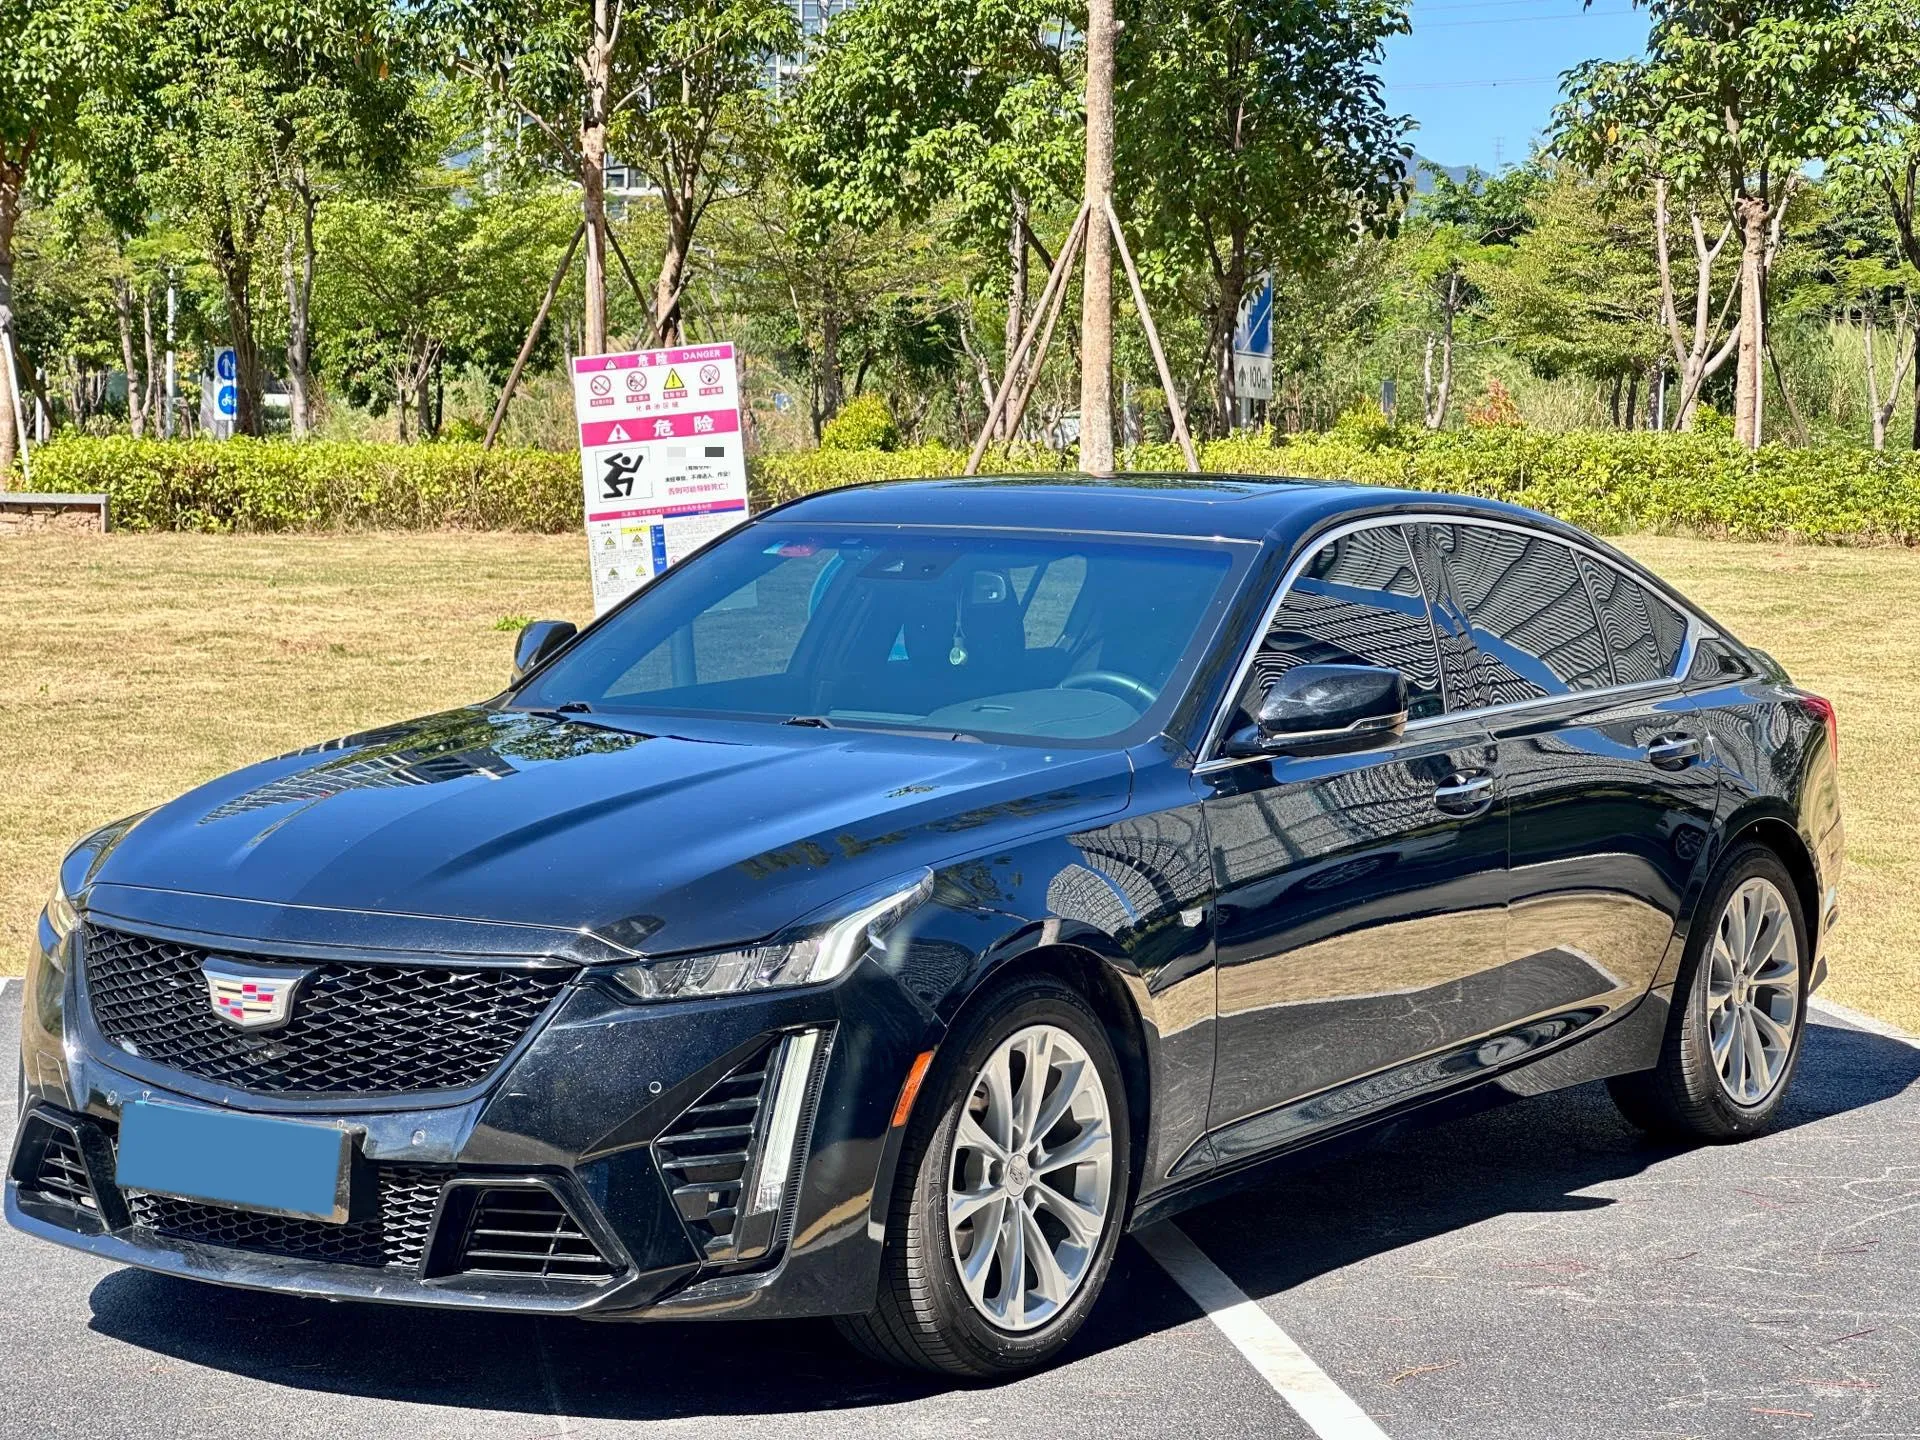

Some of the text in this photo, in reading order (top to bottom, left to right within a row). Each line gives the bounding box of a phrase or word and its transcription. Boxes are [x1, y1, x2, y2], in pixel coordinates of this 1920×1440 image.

[682, 349, 721, 361] DANGER
[1249, 366, 1267, 389] 100m
[652, 414, 715, 438] 危险
